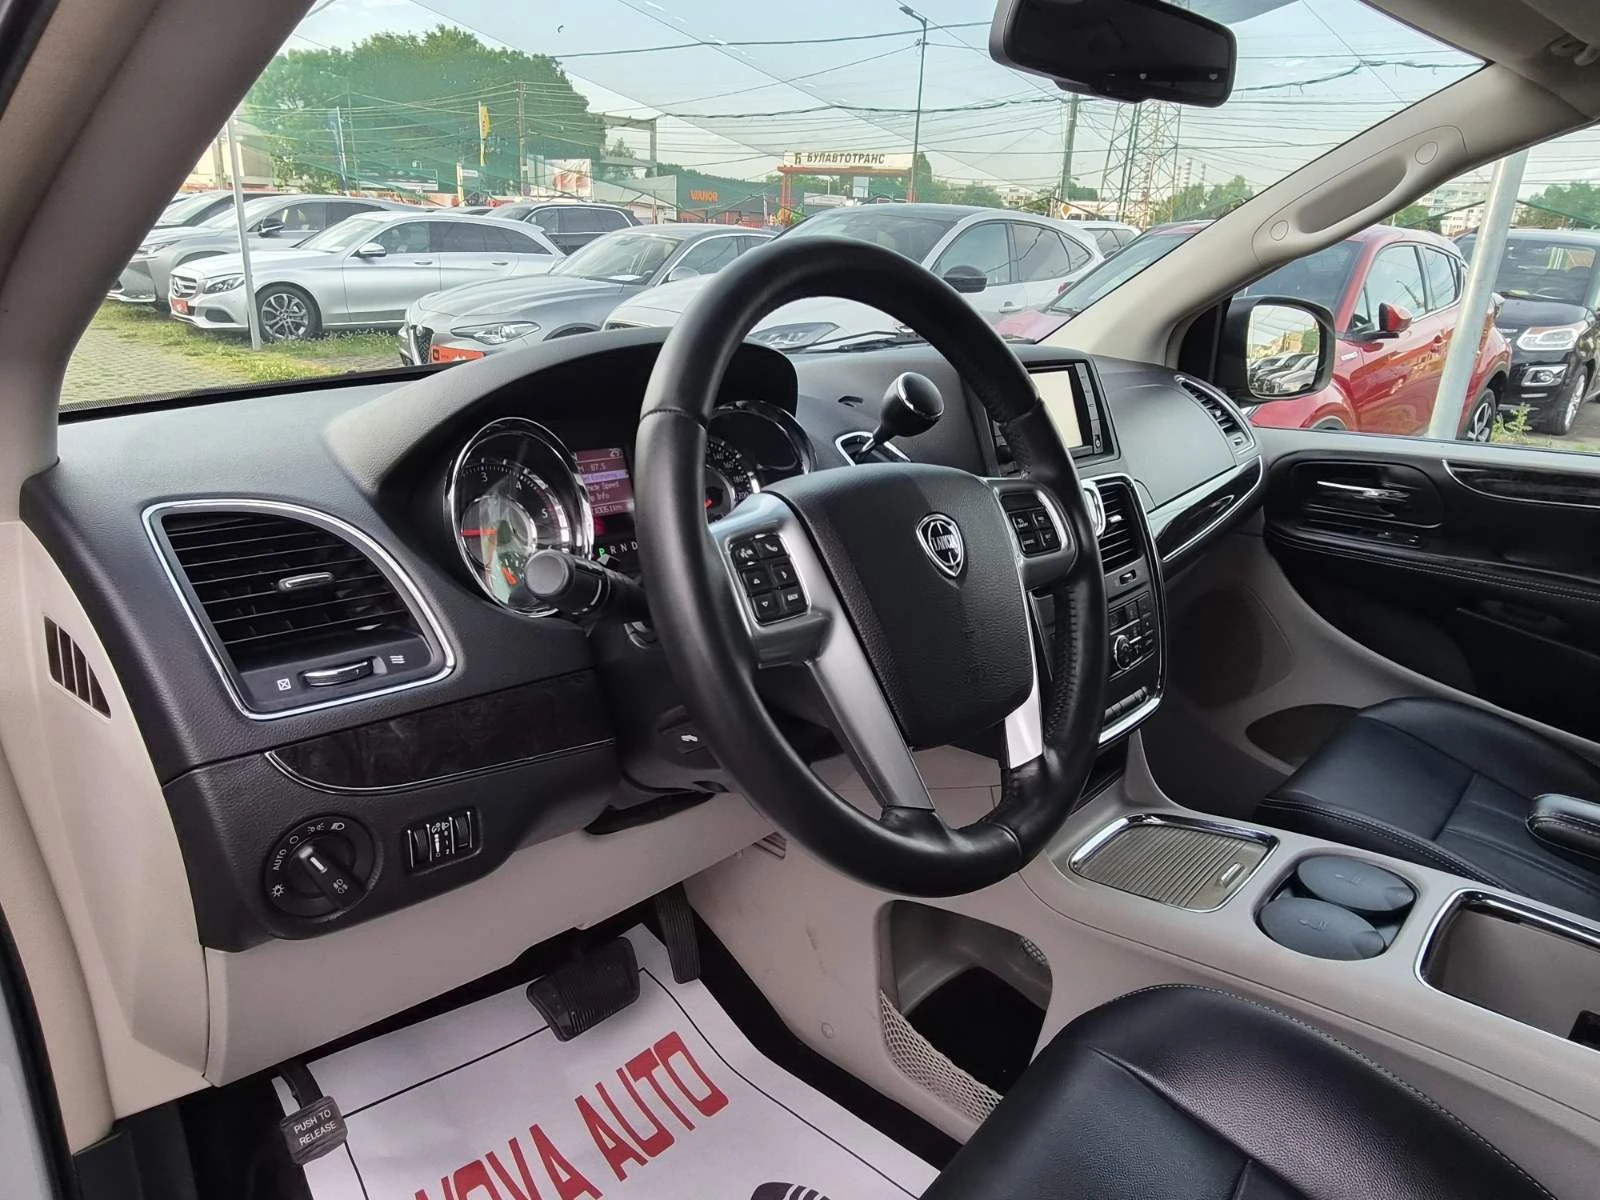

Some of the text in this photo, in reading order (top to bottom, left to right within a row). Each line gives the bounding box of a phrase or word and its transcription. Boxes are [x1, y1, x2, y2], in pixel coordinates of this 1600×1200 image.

[806, 152, 886, 164] БУЛАВТОТРАНС
[272, 848, 288, 871] AUTO
[574, 1030, 730, 1183] AUTO
[293, 1109, 331, 1135] PUSH TO
[298, 1120, 338, 1147] RELEASE
